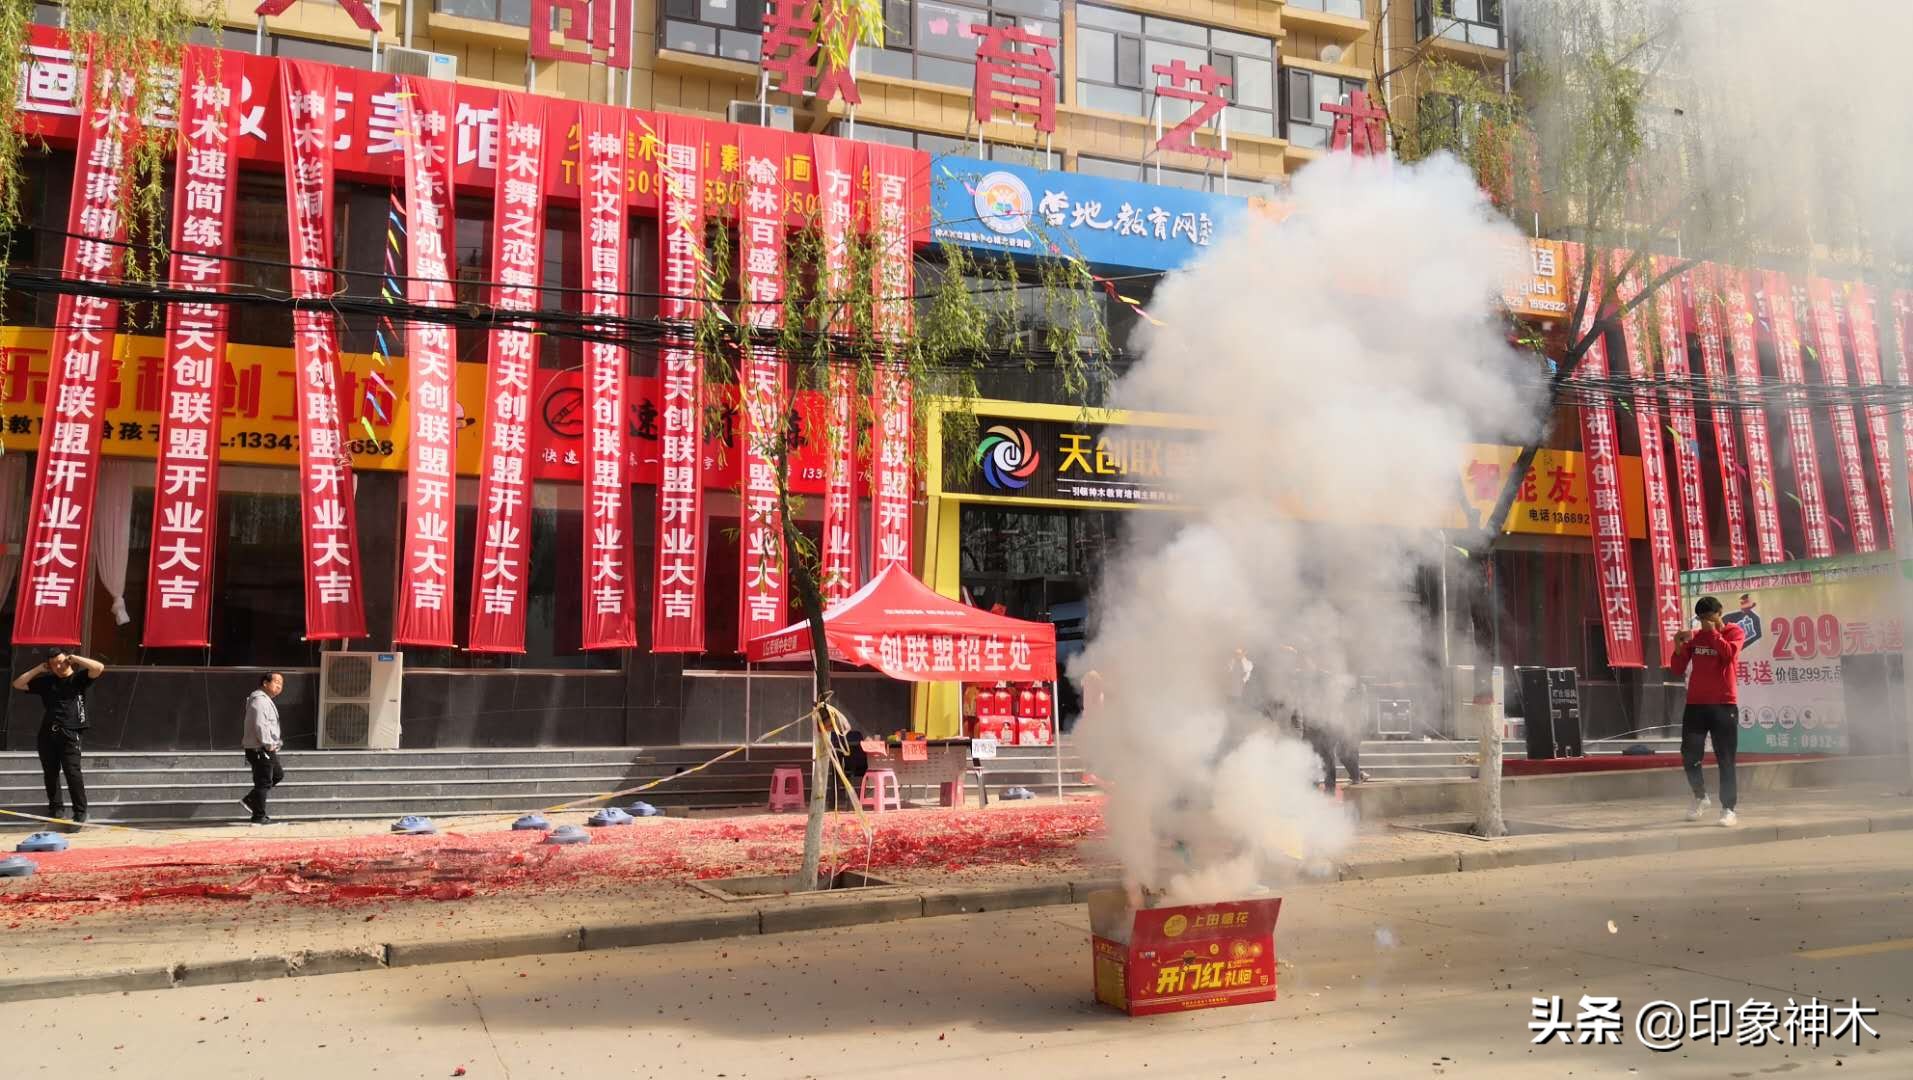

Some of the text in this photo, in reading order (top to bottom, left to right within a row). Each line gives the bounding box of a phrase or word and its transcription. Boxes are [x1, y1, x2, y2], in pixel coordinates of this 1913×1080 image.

[157, 81, 231, 609] 神木速简练字祝天创联盟开业大吉
[660, 143, 697, 618] 国酒茅台王子祝天创联盟开业大吉
[854, 633, 1032, 673] 天创联盟招生处
[1156, 962, 1225, 994] 开门红
